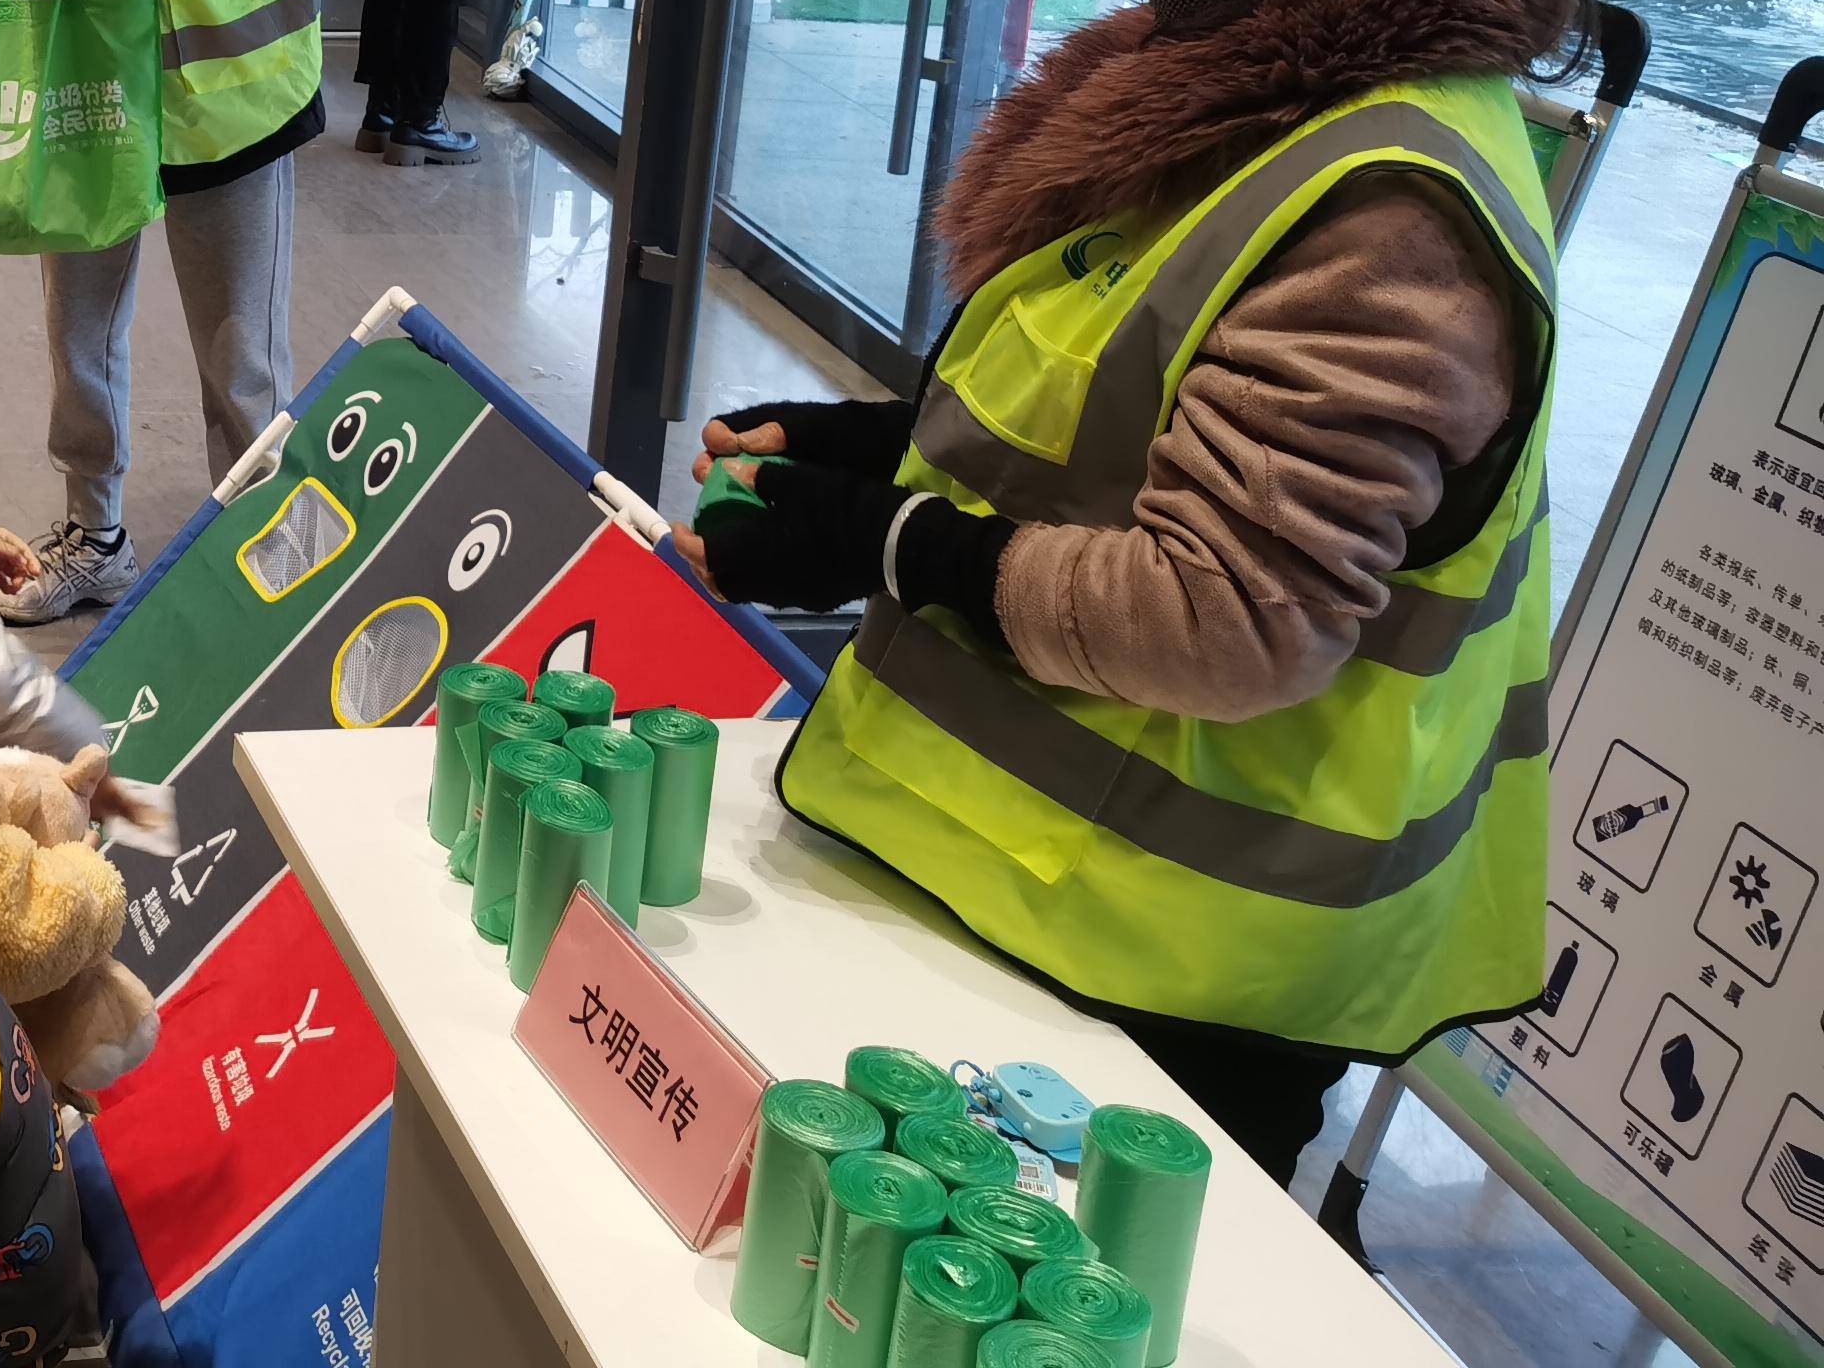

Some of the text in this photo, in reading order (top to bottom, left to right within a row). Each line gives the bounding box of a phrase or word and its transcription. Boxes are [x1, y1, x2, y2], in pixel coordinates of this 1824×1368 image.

[41, 106, 127, 141] 全民行动
[142, 886, 171, 938] 其他垃圾
[1577, 870, 1620, 913] 玻璃
[128, 899, 156, 955] Other waste
[1698, 964, 1745, 1008] 金属
[569, 984, 699, 1143] 文明宣传
[1509, 1025, 1551, 1070] 塑料
[221, 1046, 255, 1107] 有害垃圾
[1747, 1233, 1797, 1287] 纸张
[339, 1287, 372, 1368] 可回收
